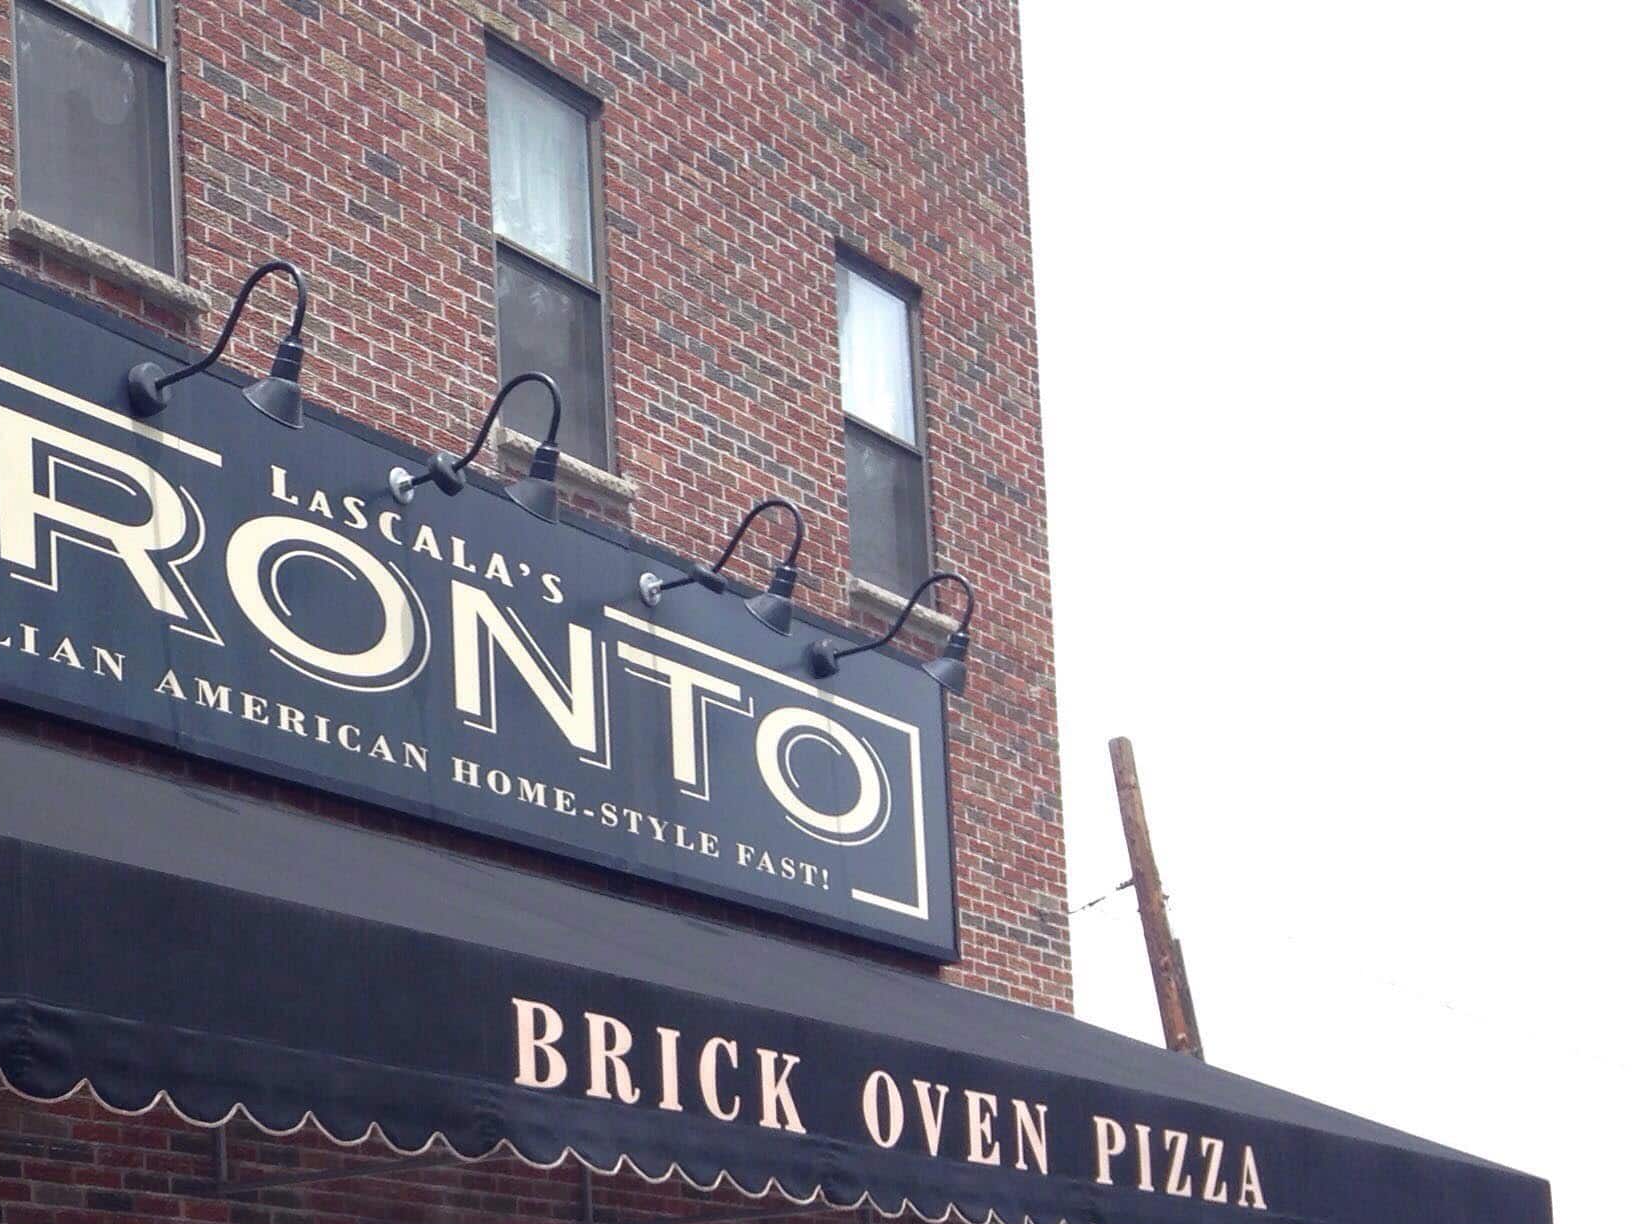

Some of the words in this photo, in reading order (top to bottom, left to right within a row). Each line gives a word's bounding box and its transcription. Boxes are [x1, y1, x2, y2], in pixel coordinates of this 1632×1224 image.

[270, 464, 565, 605] LASCALA'S
[154, 669, 430, 773] AMERICAN
[450, 756, 720, 860] HOME-STYLE
[736, 842, 832, 892] FAST!
[511, 997, 807, 1135] BRICK
[862, 1070, 1049, 1176] OVEN
[1093, 1115, 1268, 1211] PIZZA
